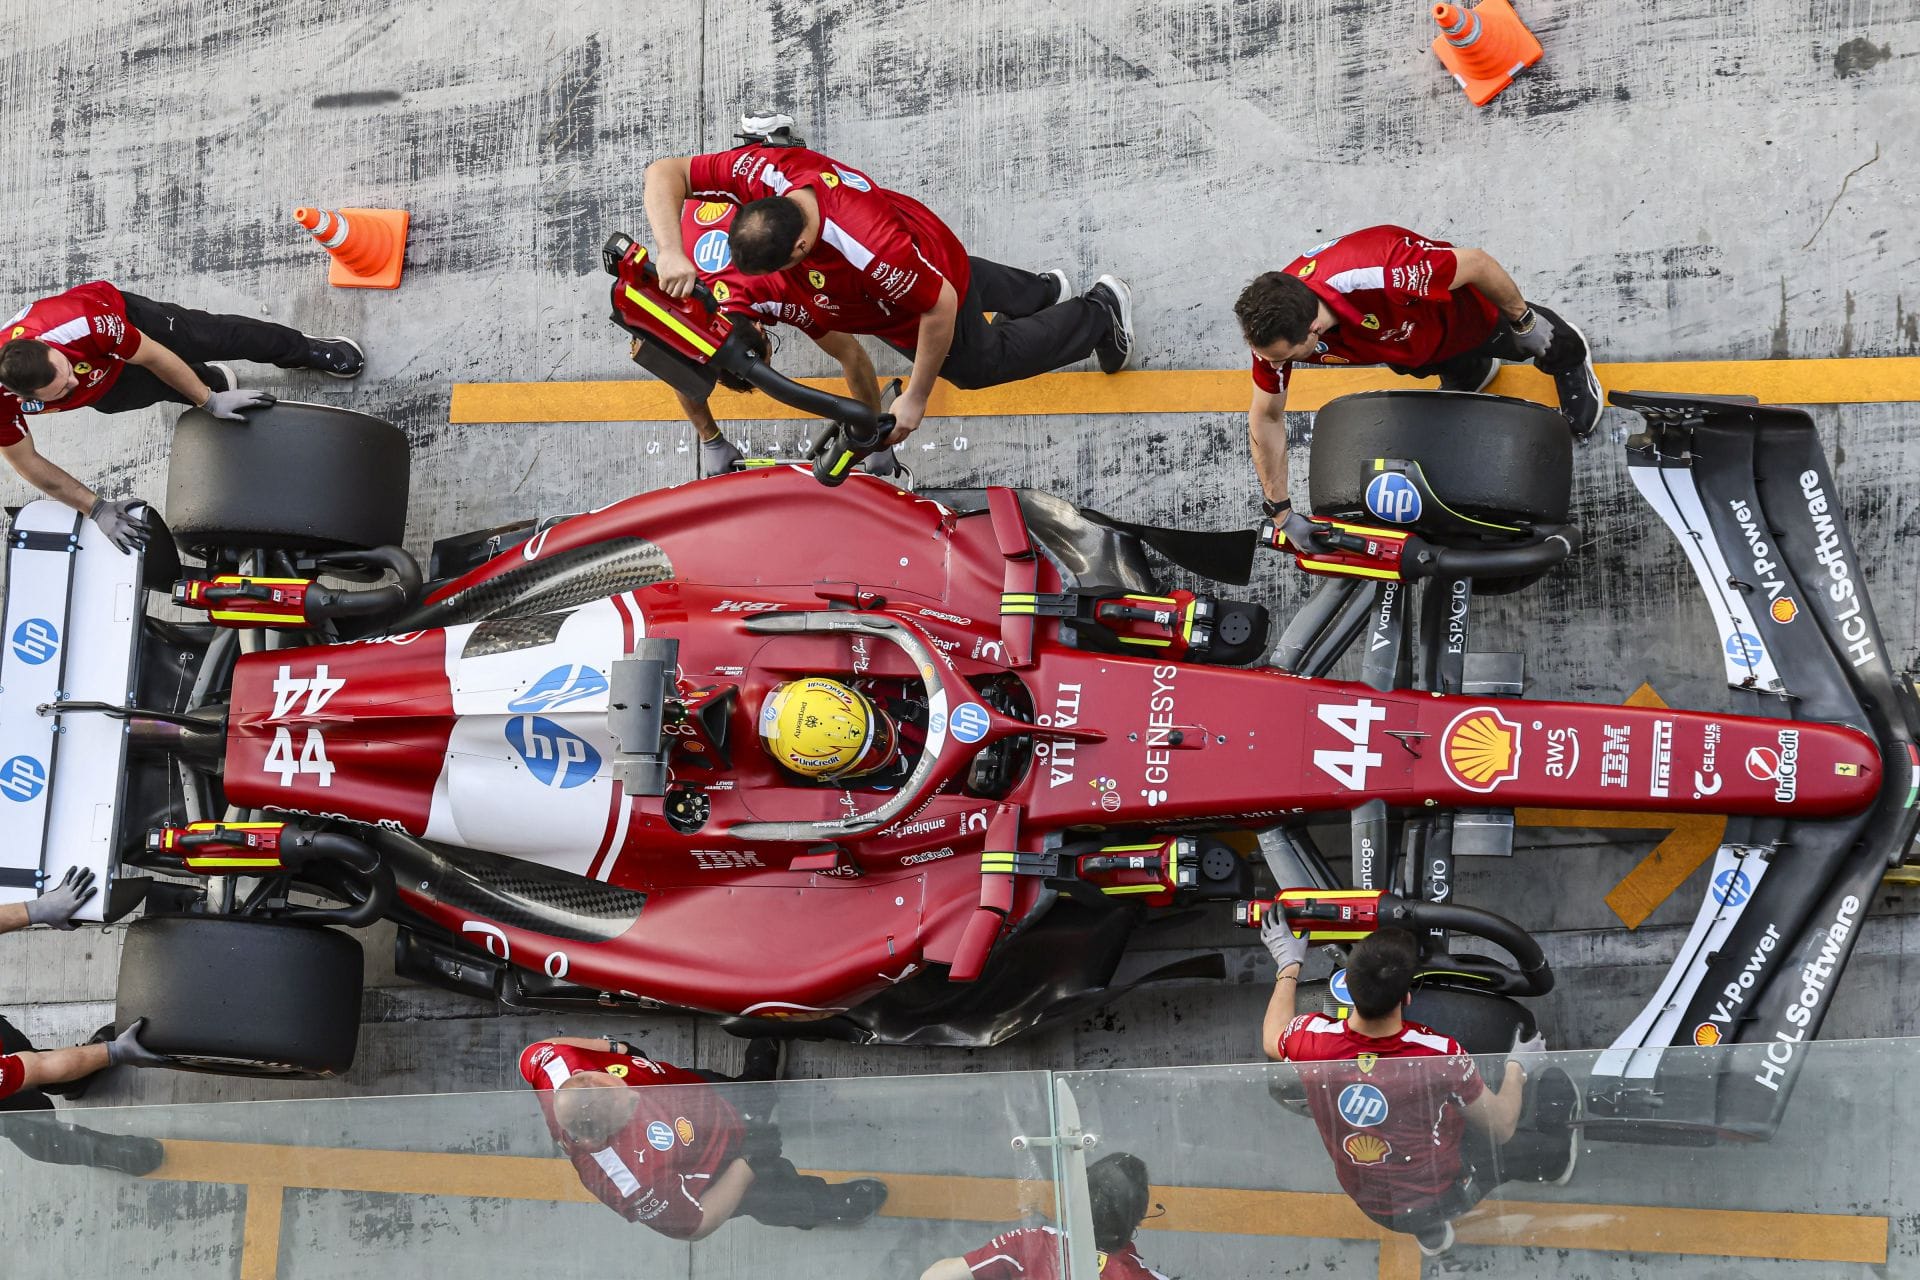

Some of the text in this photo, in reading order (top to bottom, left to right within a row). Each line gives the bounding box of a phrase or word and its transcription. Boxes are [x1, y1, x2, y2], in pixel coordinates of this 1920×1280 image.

[1391, 268, 1401, 288] aws
[1366, 472, 1423, 523] hp
[1729, 499, 1786, 600] V-Power
[1800, 469, 1876, 667] HCLSoftware
[1378, 582, 1398, 631] vantag
[1448, 580, 1467, 655] ESPACIO
[12, 618, 59, 665] hp
[269, 664, 346, 720] 44
[662, 724, 698, 736] CG
[950, 702, 990, 743] hp
[1145, 665, 1177, 784] GENESYS
[1313, 699, 1386, 791] 44
[263, 727, 336, 787] 44
[504, 715, 602, 789] hp
[799, 756, 840, 767] UniCredit
[1544, 727, 1566, 777] aws
[1600, 724, 1631, 788] IBM
[1650, 719, 1673, 797] PIRELLI
[1703, 724, 1716, 772] CELSIUS
[1775, 729, 1799, 802] UniCredit
[0, 755, 46, 802] hp
[901, 818, 946, 836] ambipar
[690, 850, 766, 869] IBM
[911, 847, 954, 863] UniCredit
[1361, 838, 1374, 890] antage
[1713, 869, 1751, 906] hp
[1709, 923, 1781, 1024] V-Power
[1755, 895, 1859, 1092] HCLSoftware
[1338, 1084, 1388, 1127] hp
[647, 1121, 674, 1151] hp
